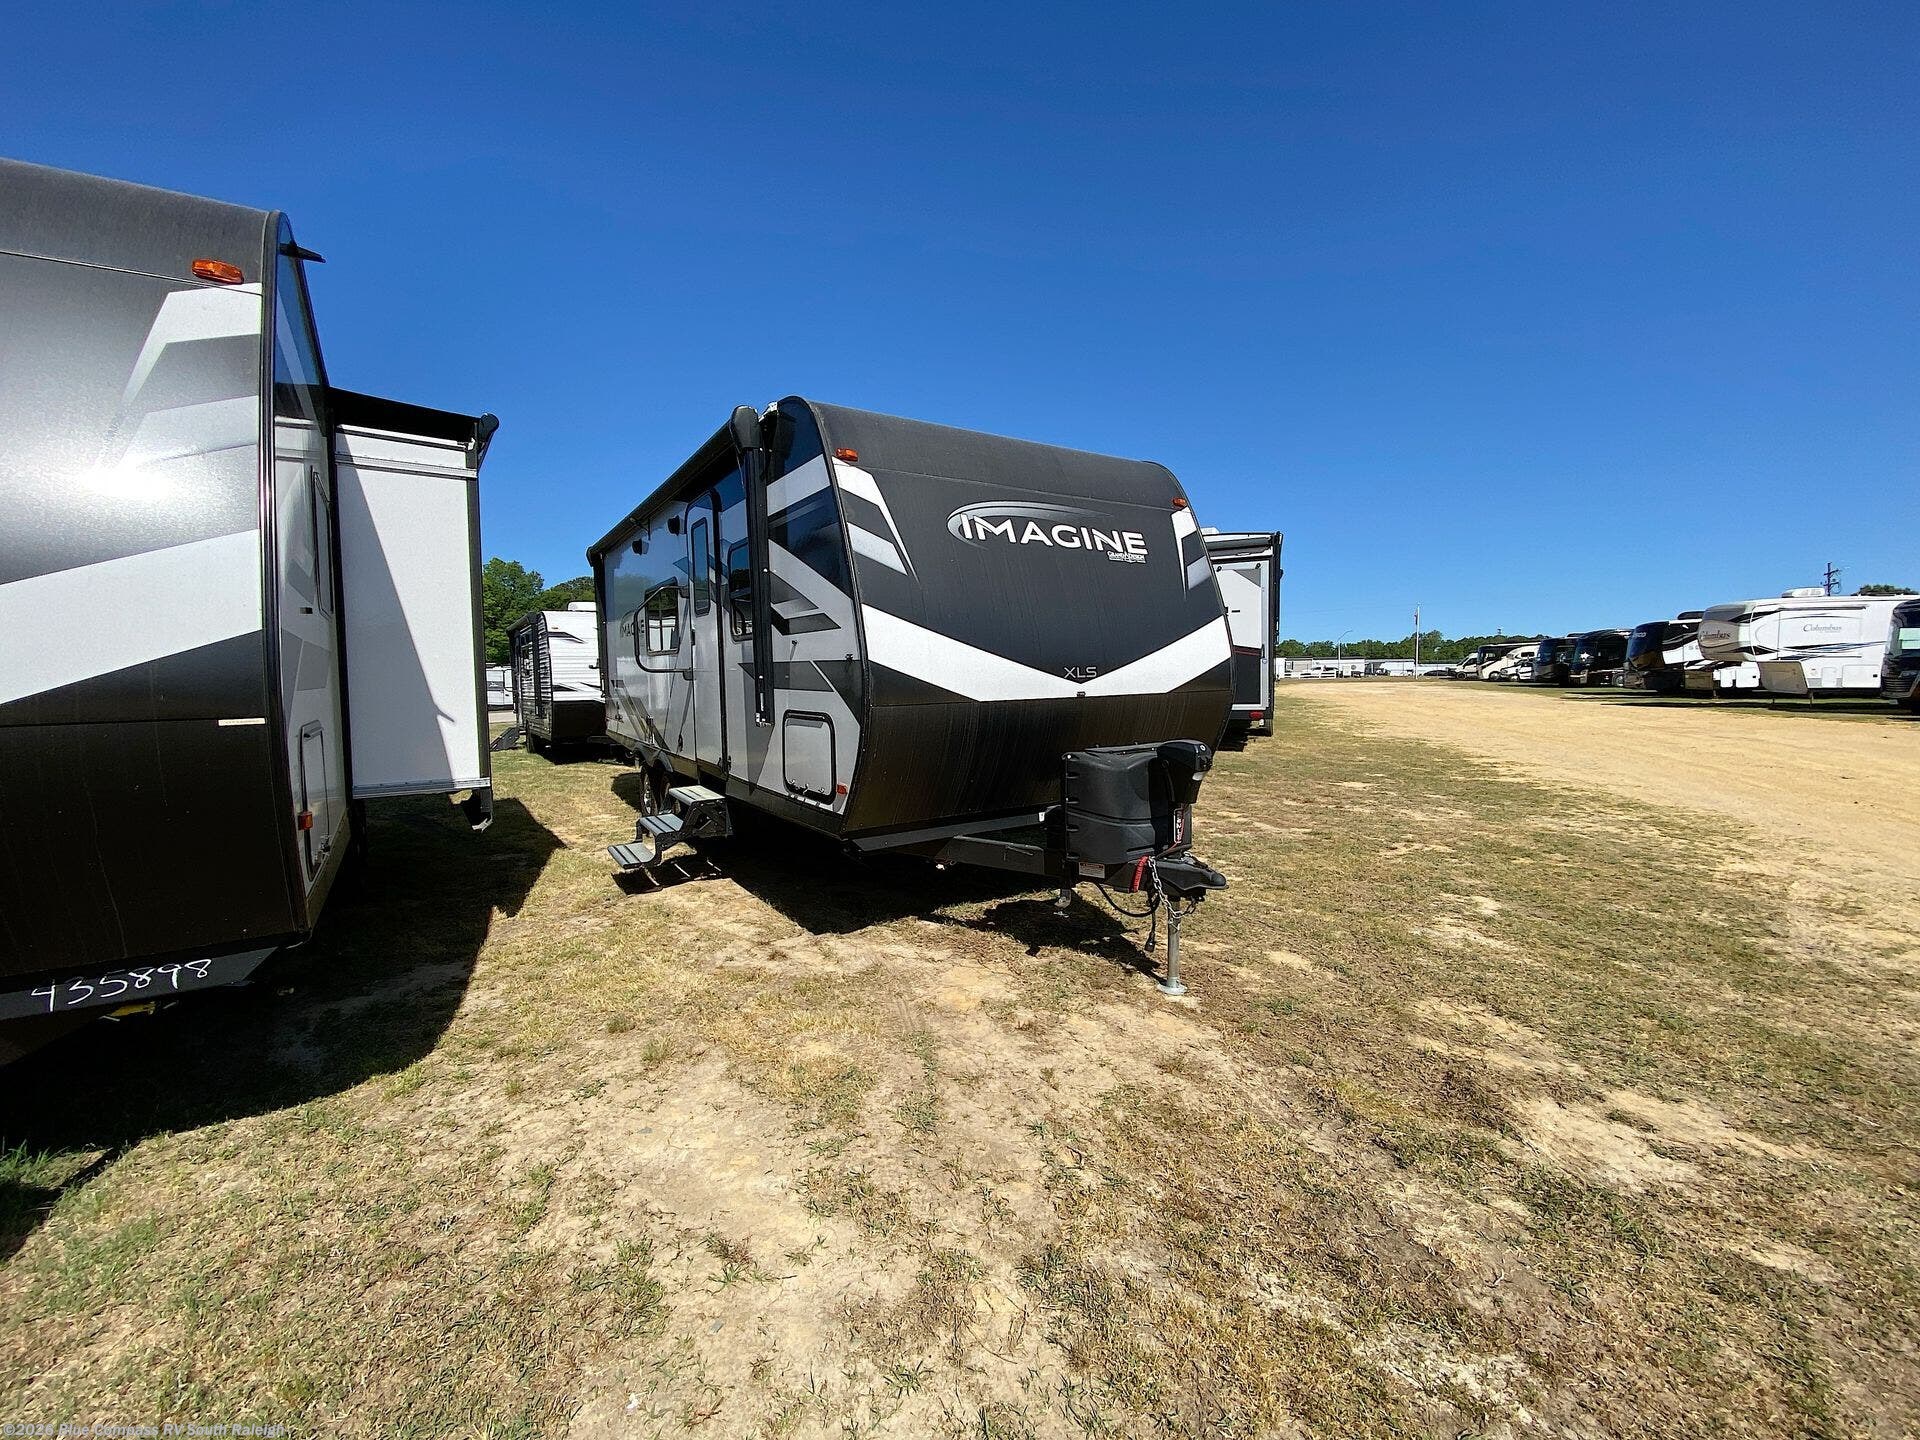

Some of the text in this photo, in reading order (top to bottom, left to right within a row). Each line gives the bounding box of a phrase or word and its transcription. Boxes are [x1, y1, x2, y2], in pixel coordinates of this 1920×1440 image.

[960, 512, 1148, 554] IMAGINE
[1064, 666, 1097, 678] XLS
[31, 959, 212, 1012] 435898
